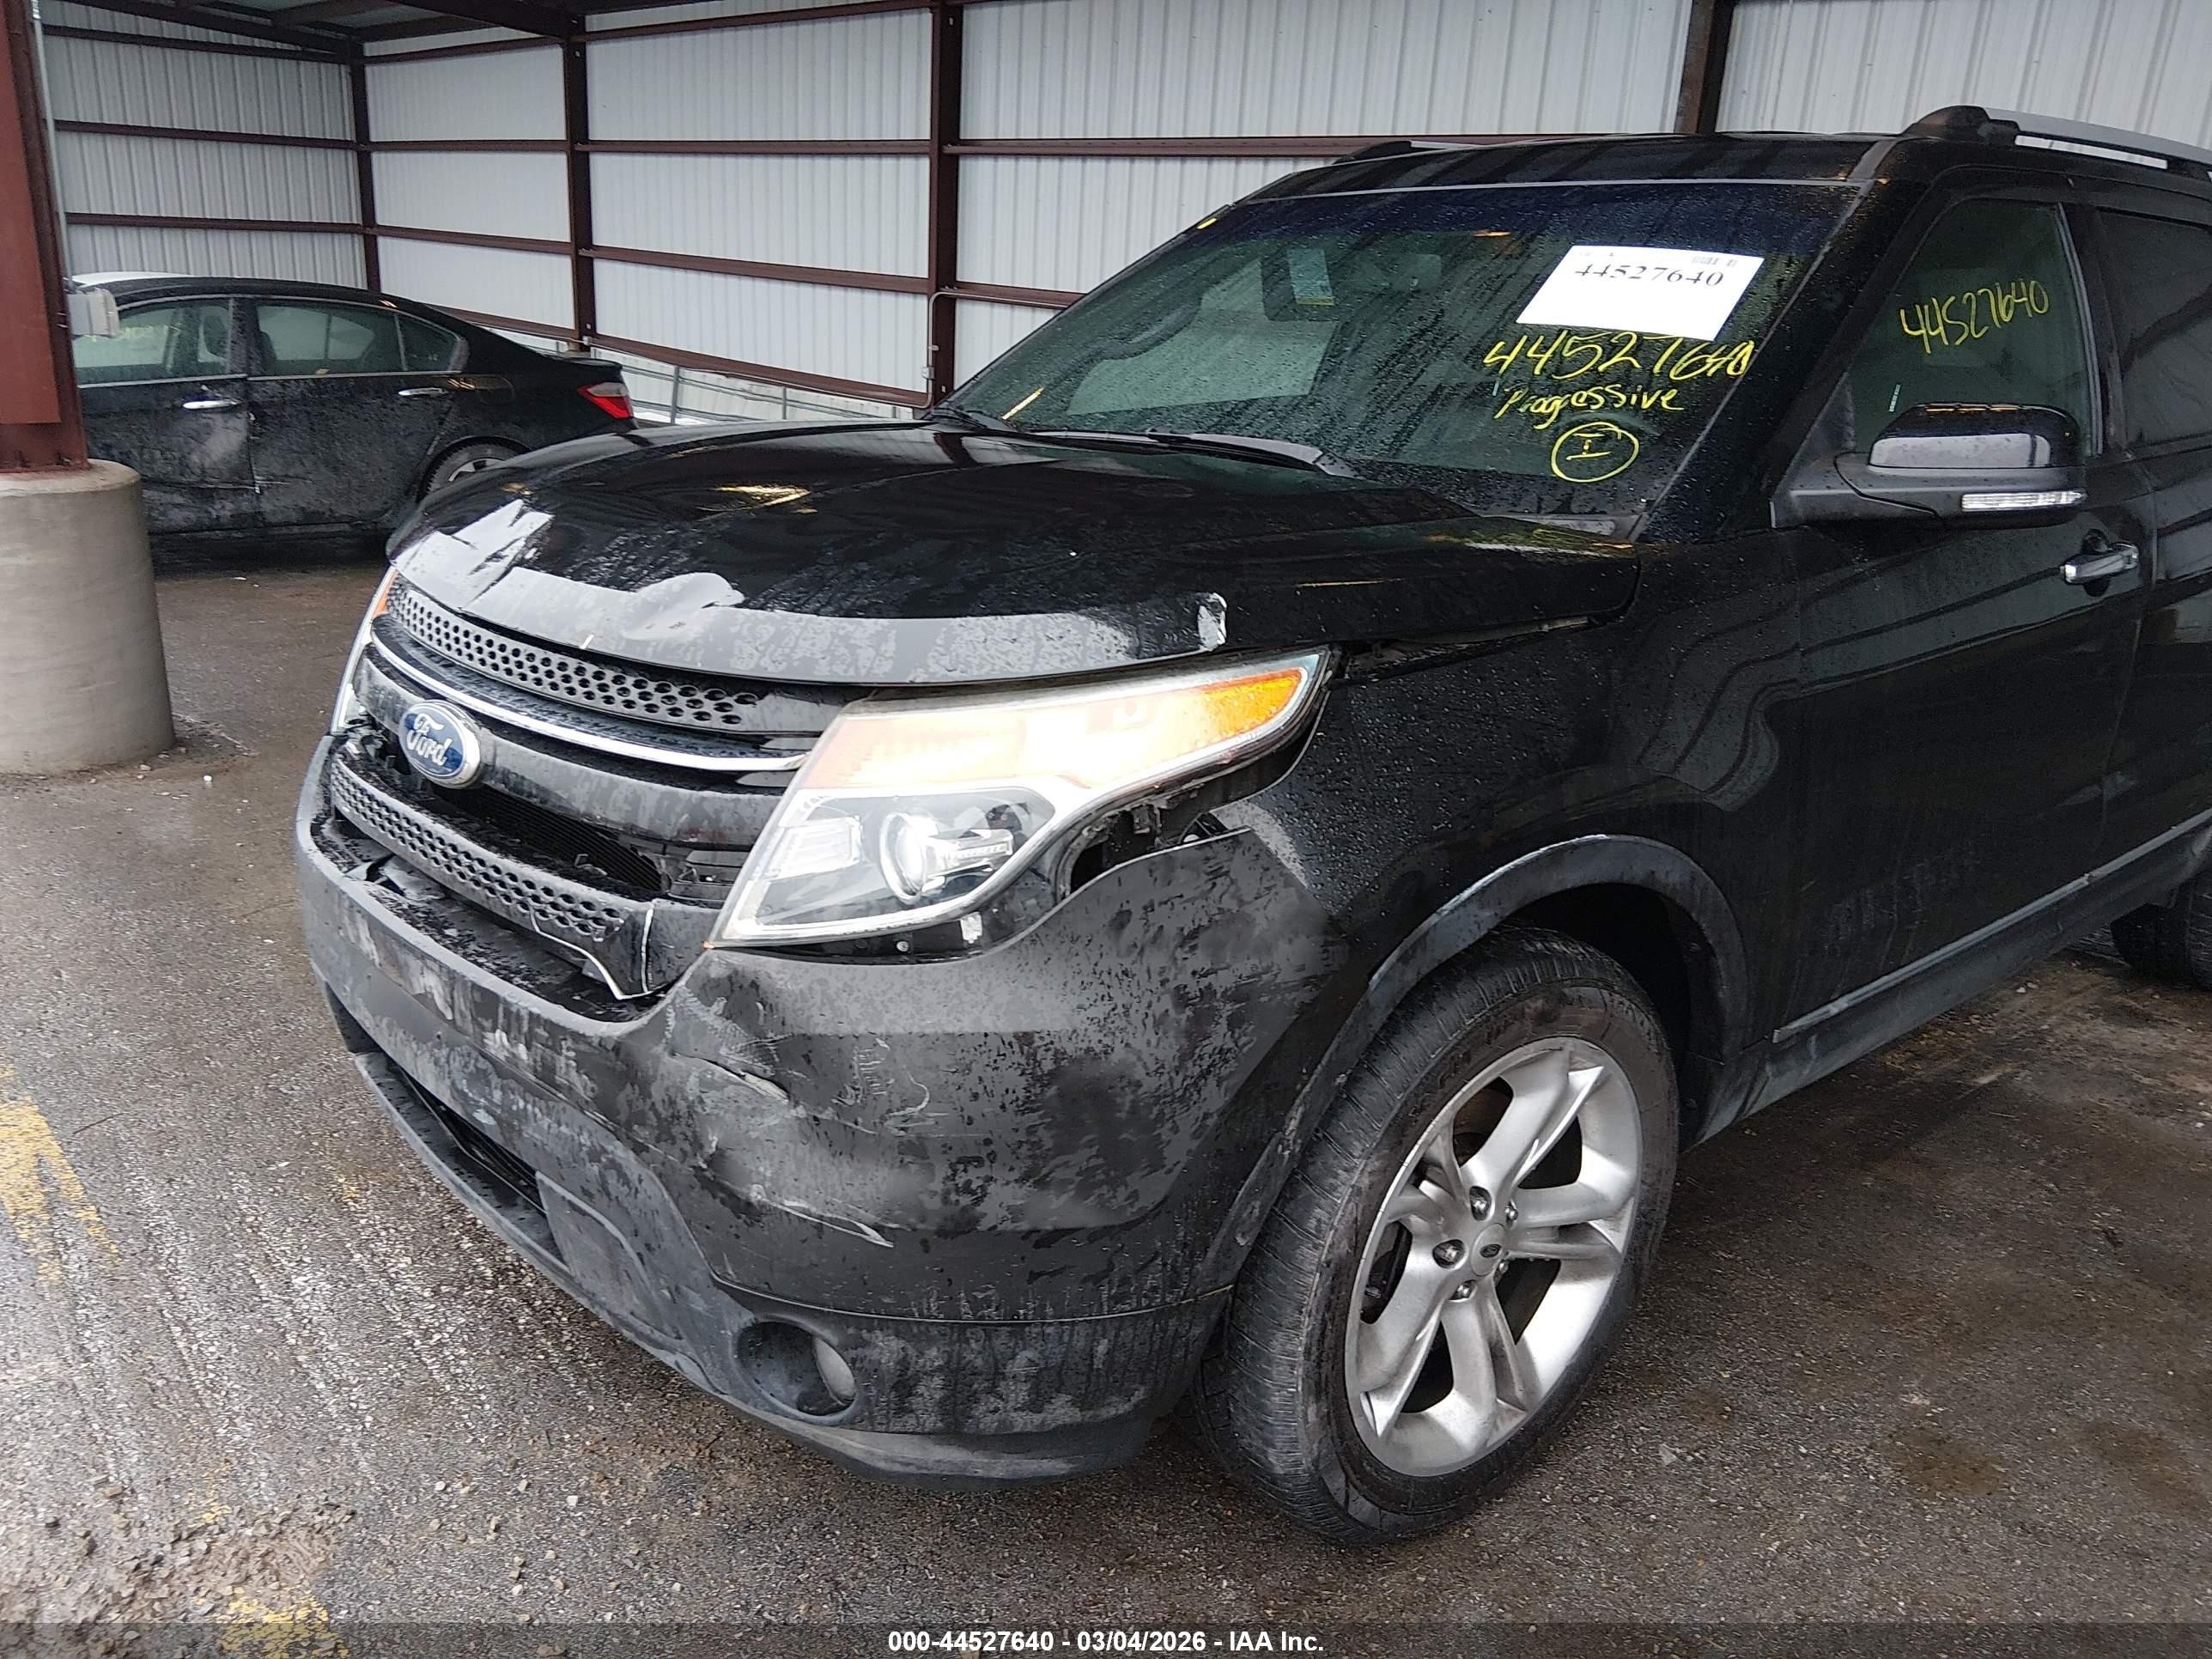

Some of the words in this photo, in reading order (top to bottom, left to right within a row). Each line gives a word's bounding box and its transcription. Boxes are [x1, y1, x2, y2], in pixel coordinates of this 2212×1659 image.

[1574, 264, 1724, 286] 44527640
[1899, 279, 2049, 354] 44527640
[1483, 330, 1755, 380] 44527640
[406, 713, 453, 766] Ford
